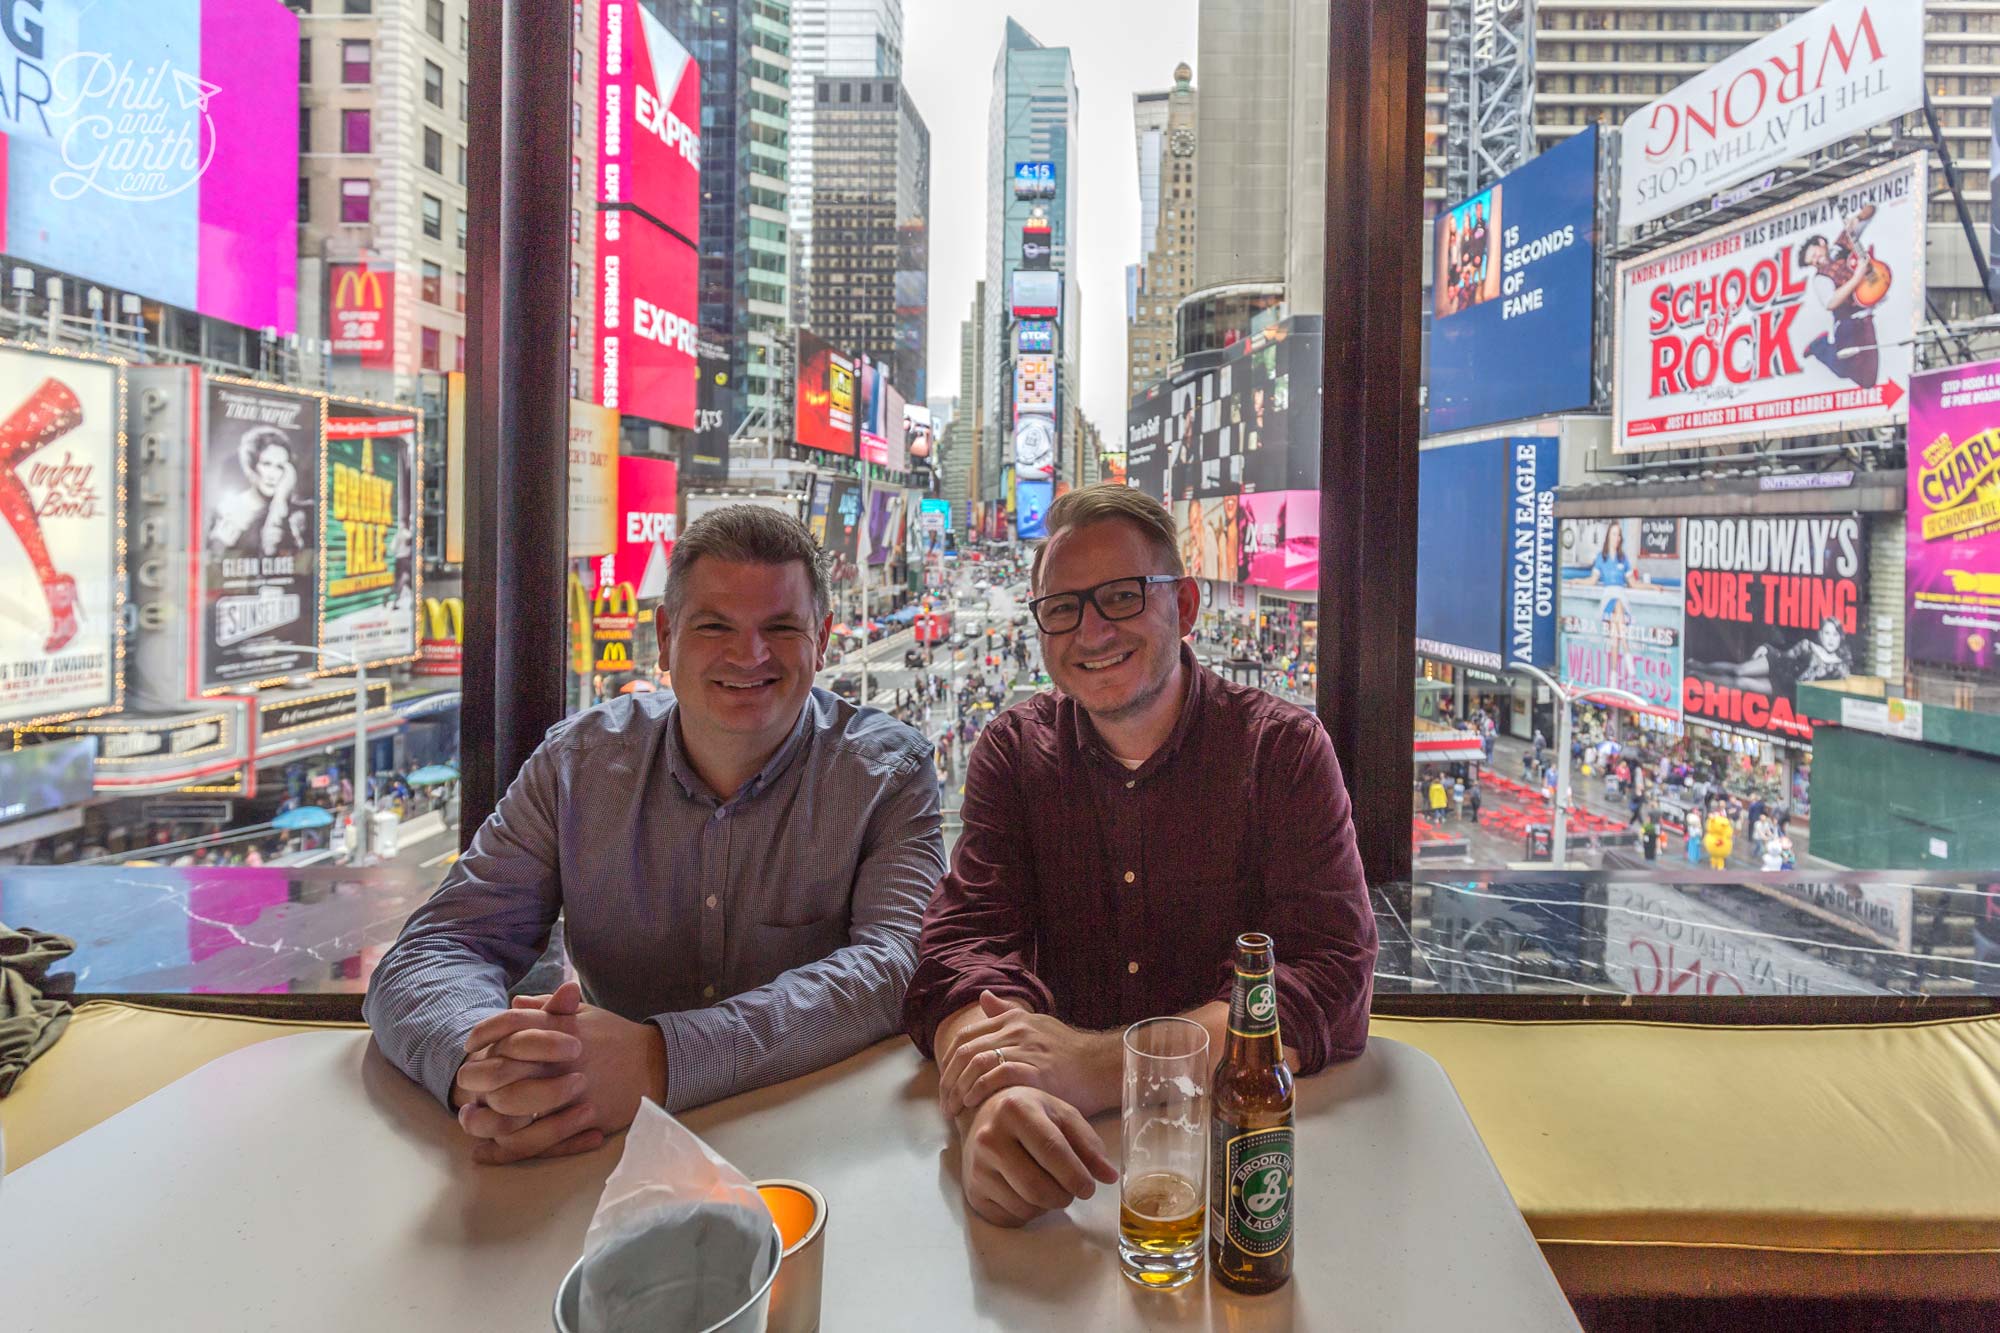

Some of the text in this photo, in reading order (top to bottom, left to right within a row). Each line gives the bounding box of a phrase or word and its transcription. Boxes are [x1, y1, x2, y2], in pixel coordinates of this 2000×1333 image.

[607, 4, 622, 75] EXPRESS
[1645, 5, 1887, 157] WRONG
[1836, 68, 1890, 113] THE
[605, 85, 621, 156] EXPRESS
[1765, 94, 1827, 149] PLAY
[1020, 164, 1050, 178] 4:15
[1701, 133, 1759, 175] THAT
[605, 164, 620, 240] EXPRESS
[1637, 158, 1698, 206] GOES
[1504, 225, 1519, 249] 15
[1504, 224, 1574, 273] SECONDS
[1668, 252, 1698, 275] LLOYD
[1701, 235, 1741, 262] WEBBER
[1744, 228, 1765, 249] HAS
[1769, 204, 1835, 239] BROADWAY
[604, 256, 619, 328] EXPRESS
[1503, 271, 1525, 296] OF
[1503, 288, 1544, 320] FAME
[1650, 246, 1808, 334] SCHOOL
[339, 310, 380, 323] OPEN
[342, 322, 375, 340] 24
[1705, 307, 1734, 350] of
[603, 336, 618, 408] EXPRESS
[1650, 303, 1805, 400] ROCK
[694, 409, 723, 434] CATS
[1665, 415, 1685, 432] JUST
[1693, 409, 1725, 427] BLOCKS
[1726, 408, 1737, 422] TO
[1738, 405, 1755, 421] THE
[1756, 400, 1791, 419] WINTER
[1793, 395, 1833, 415] GARDEN
[1835, 386, 1884, 411] THEATRE
[1922, 432, 2000, 506] CHARL
[1938, 501, 1997, 531] CHOCOLATE
[1513, 444, 1536, 663] AMERICAN EAGLE
[1536, 490, 1554, 617] OUTFITTERS
[1687, 518, 1858, 577] BROADWAY'S
[228, 601, 276, 636] SUNSET
[1687, 570, 1753, 623] SURE
[1761, 574, 1857, 635] THING
[1568, 643, 1673, 703] WAITRESS
[1683, 676, 1814, 740] CHICA
[1236, 1154, 1292, 1182] BROOKLYN
[1247, 1168, 1288, 1212] B
[1245, 1208, 1286, 1231] LAGER
